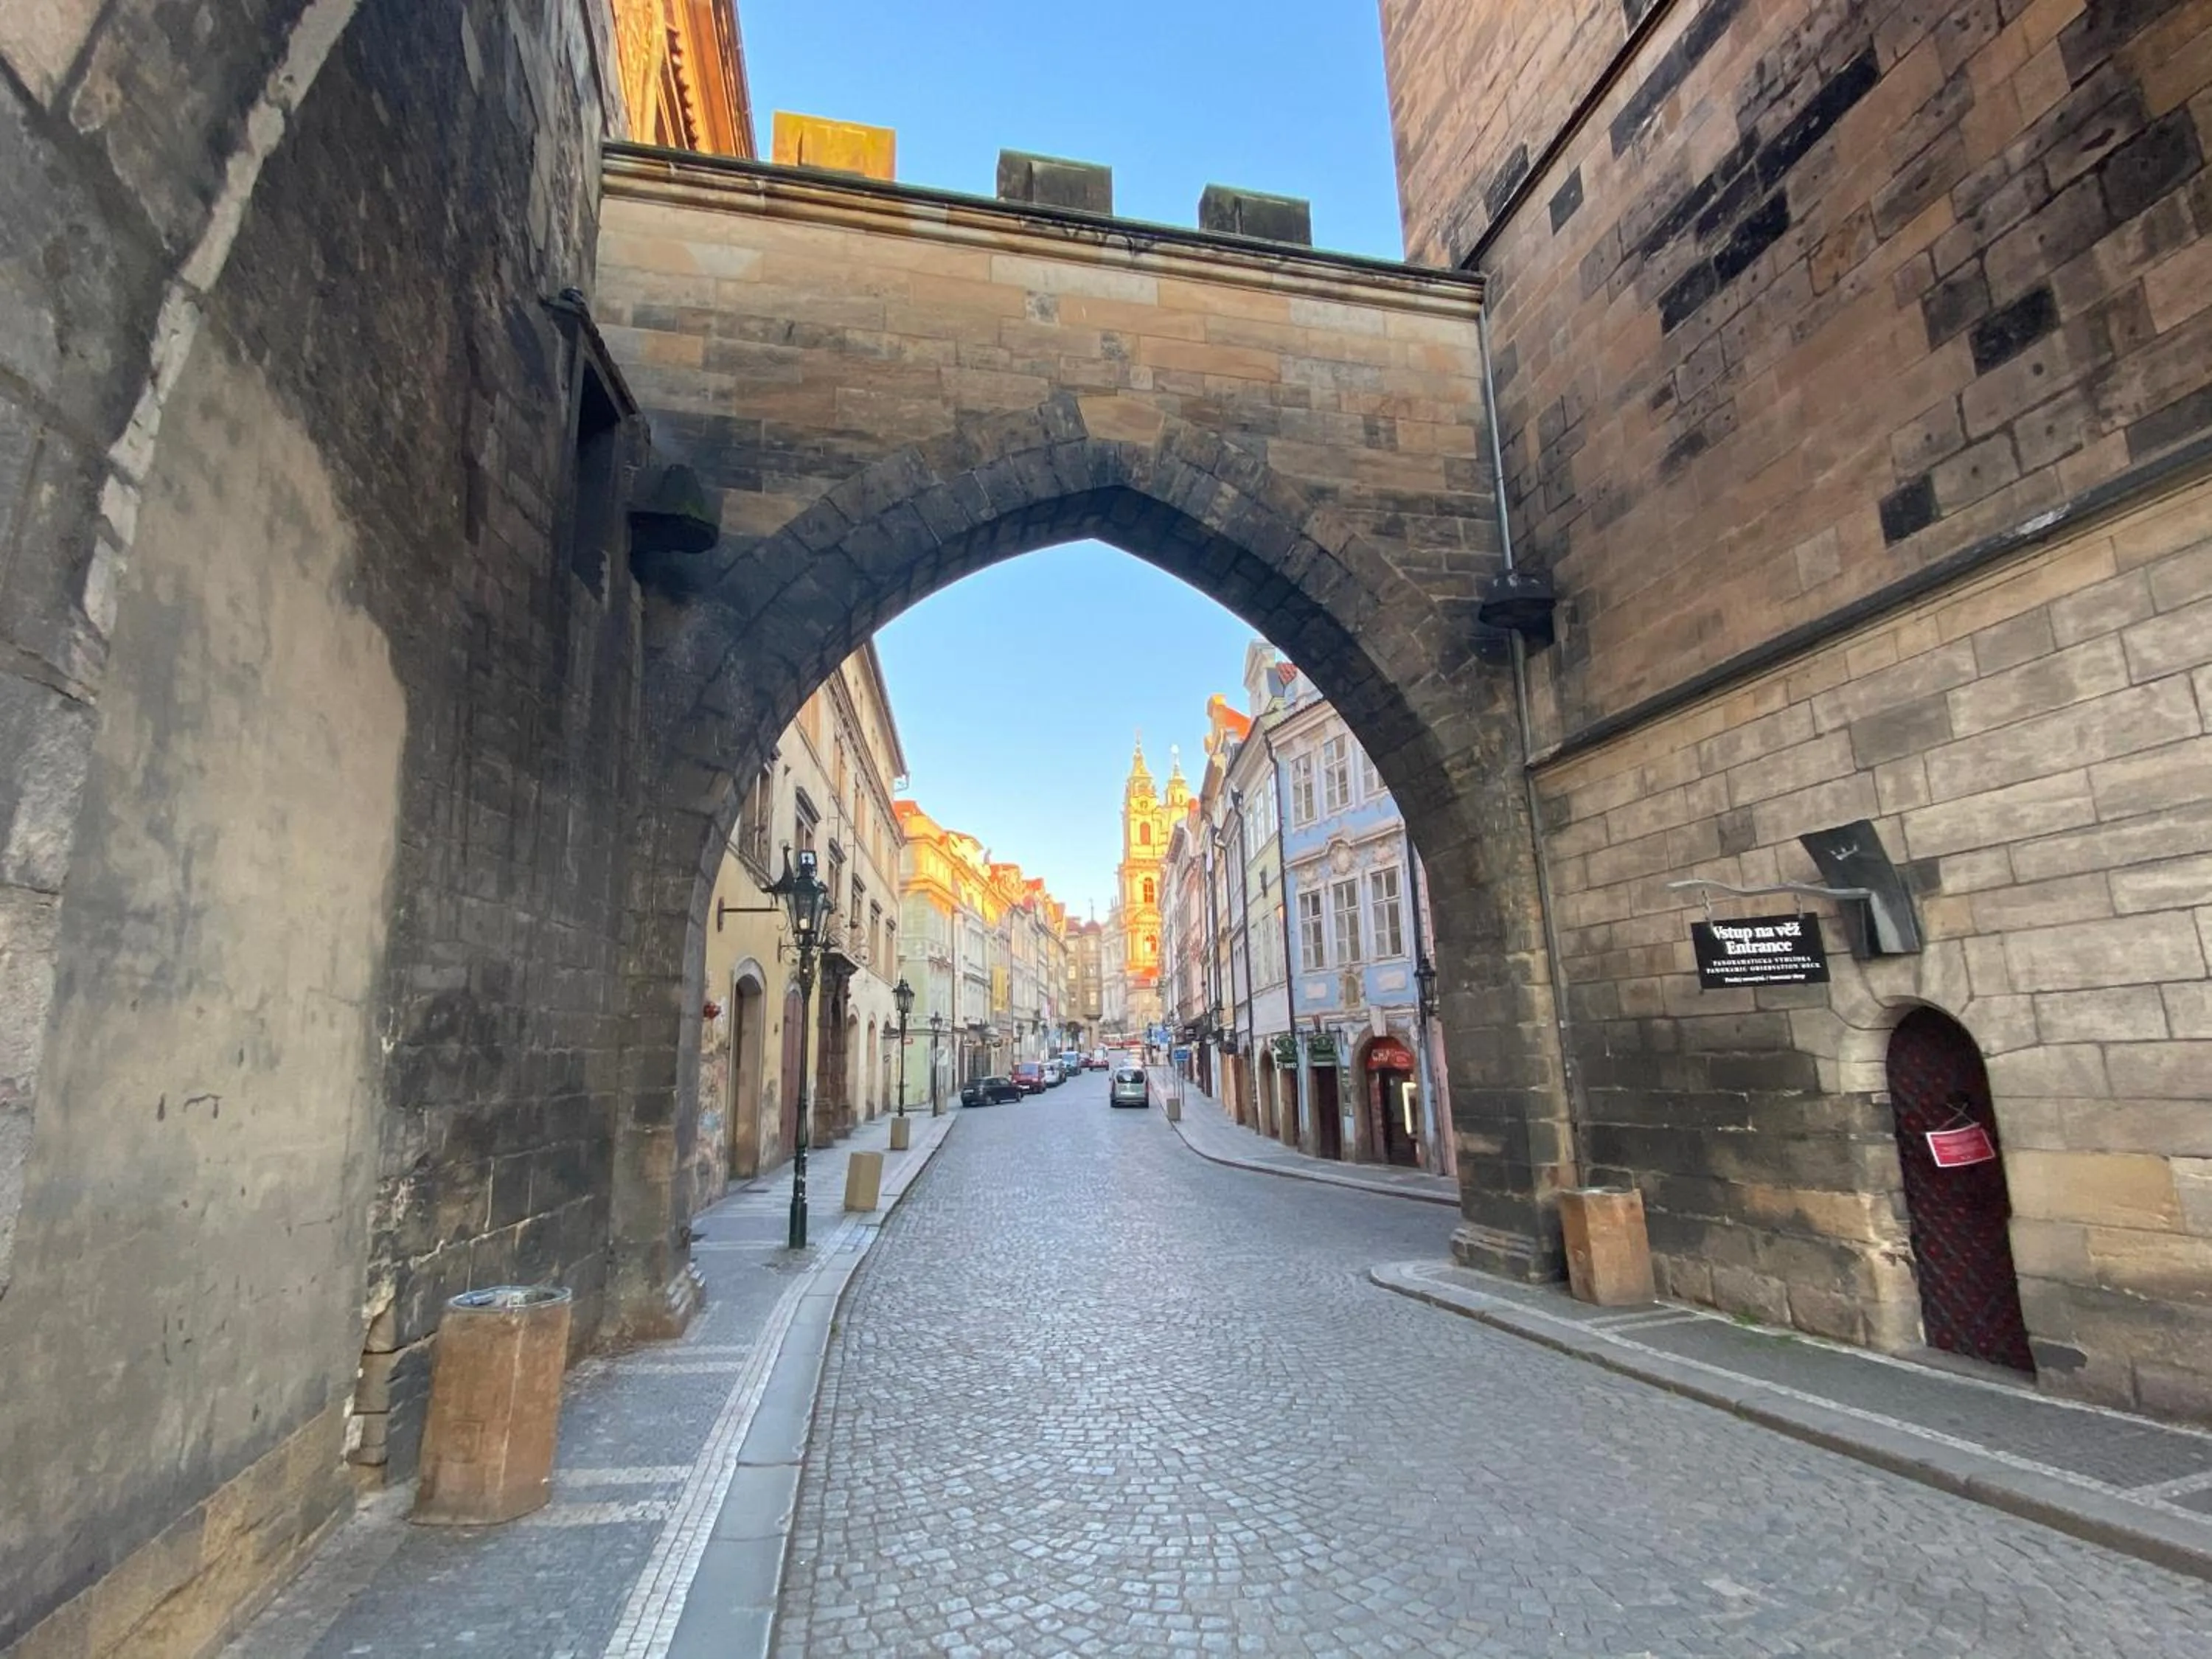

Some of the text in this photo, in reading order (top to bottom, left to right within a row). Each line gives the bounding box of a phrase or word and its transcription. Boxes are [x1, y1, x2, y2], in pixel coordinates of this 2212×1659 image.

[1712, 922, 1801, 942] Vstup na věž
[1725, 941, 1793, 954] Entrance
